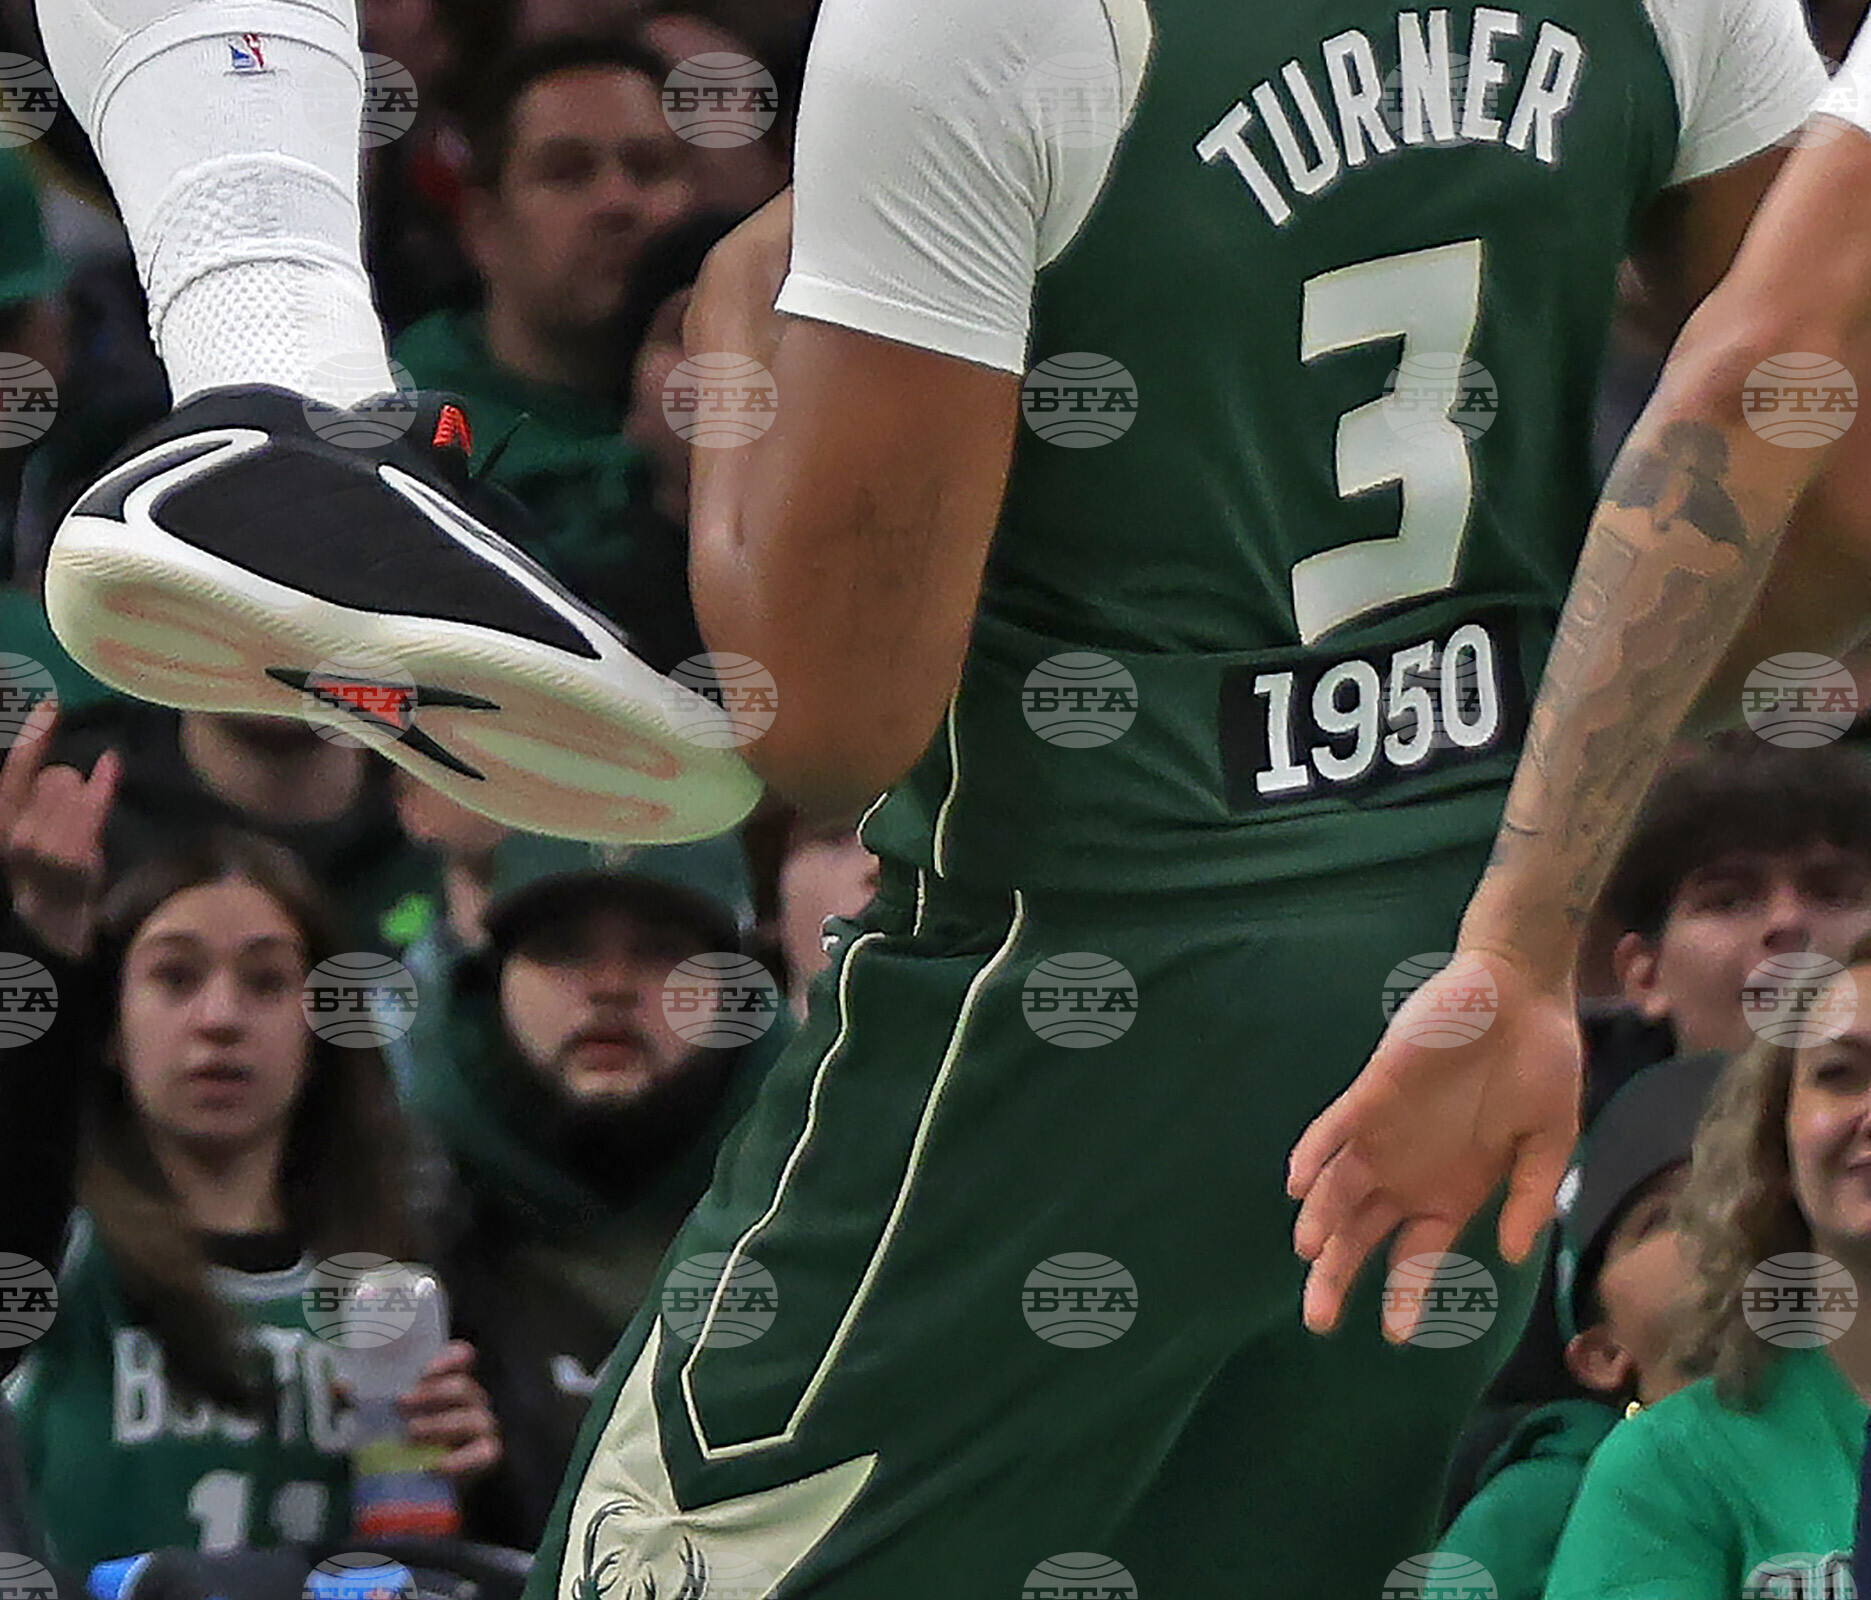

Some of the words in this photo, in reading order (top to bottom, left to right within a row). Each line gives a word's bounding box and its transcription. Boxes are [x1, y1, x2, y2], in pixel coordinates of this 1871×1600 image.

[1196, 6, 1588, 228] TURNER
[1290, 237, 1485, 648] 3
[1252, 622, 1501, 800] 1950
